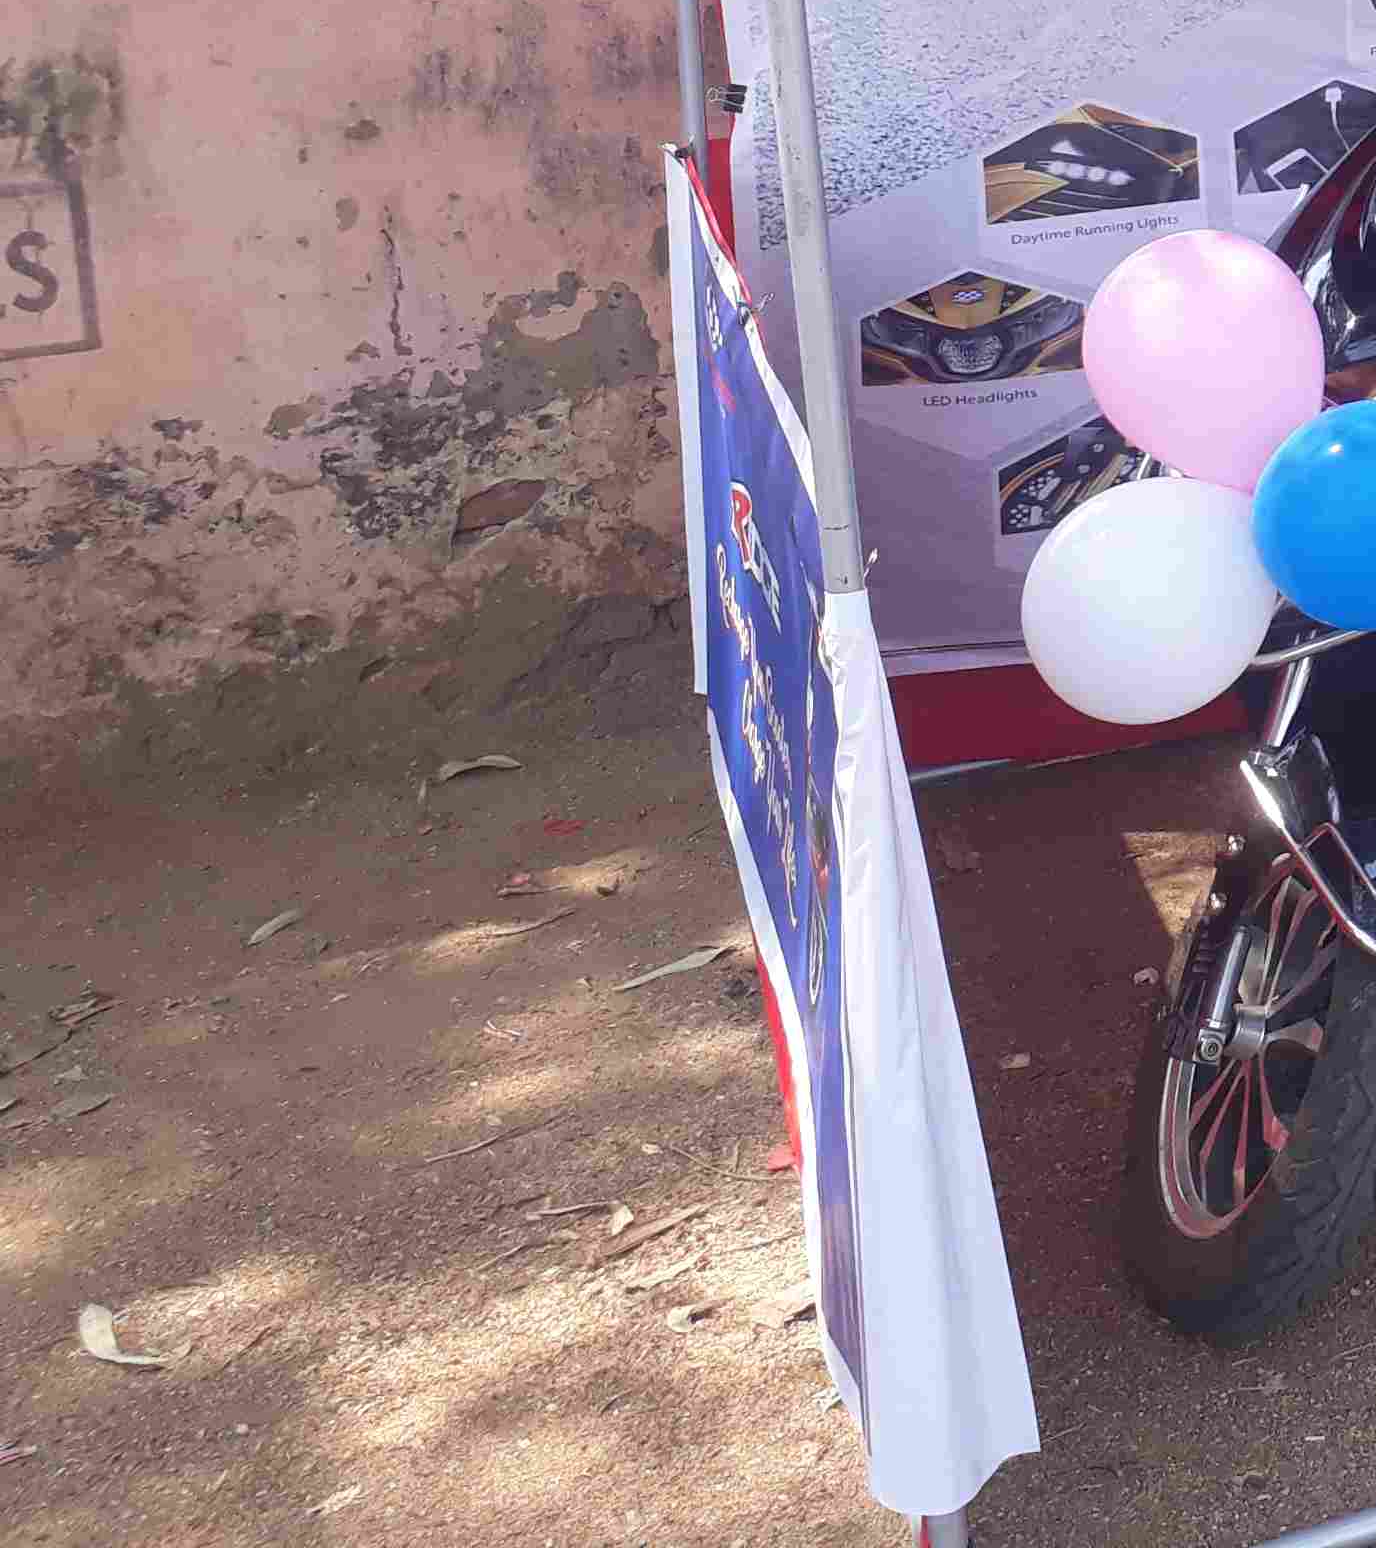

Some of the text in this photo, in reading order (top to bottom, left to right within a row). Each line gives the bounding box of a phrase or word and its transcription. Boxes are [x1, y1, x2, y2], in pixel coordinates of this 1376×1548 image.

[1011, 231, 1071, 245] Daytime
[1075, 222, 1134, 236] Running
[923, 388, 1038, 406] LED Headlights
